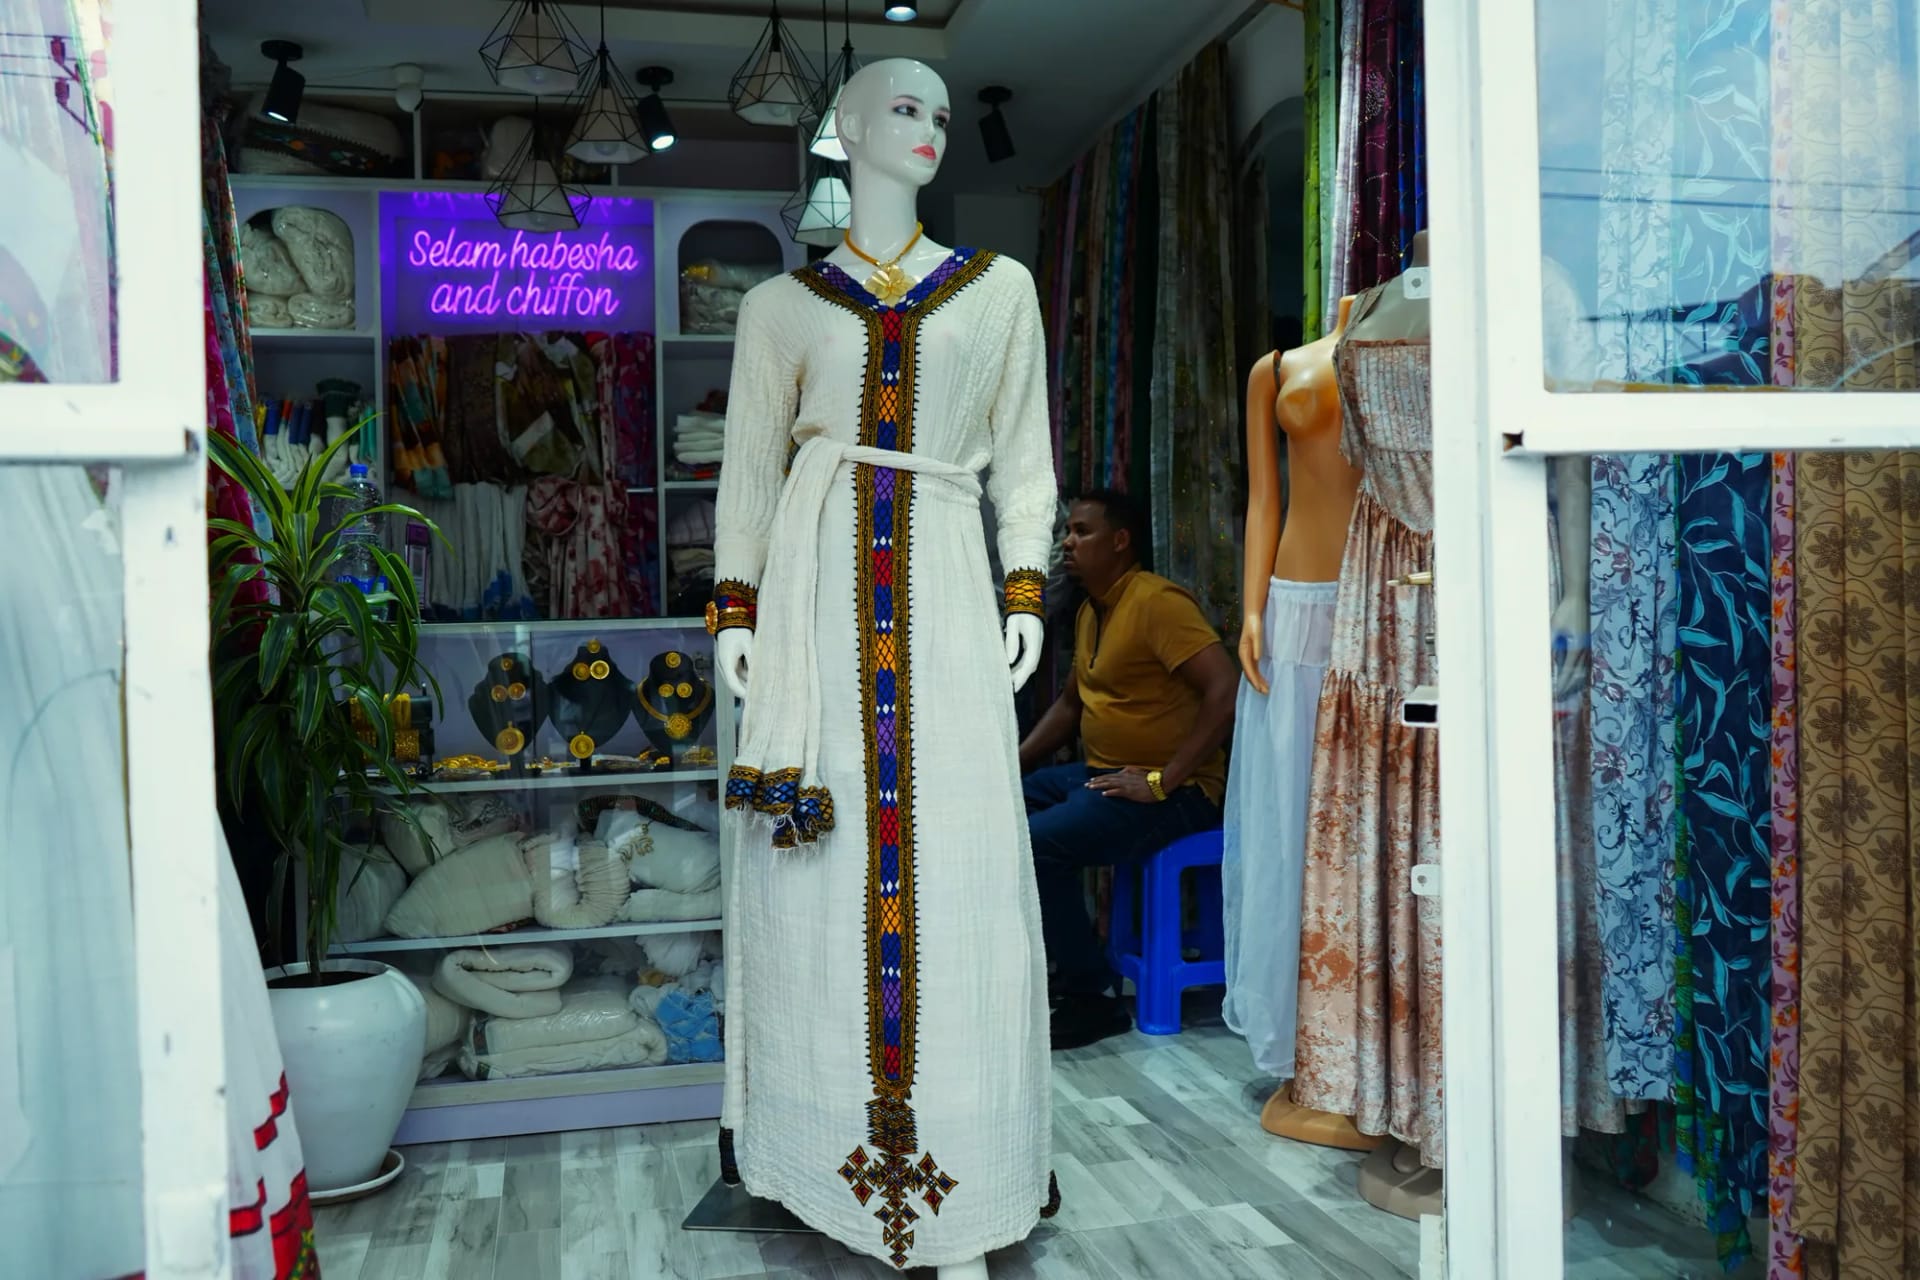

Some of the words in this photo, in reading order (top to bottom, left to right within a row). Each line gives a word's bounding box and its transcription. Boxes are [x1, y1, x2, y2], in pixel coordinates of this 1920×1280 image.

[408, 228, 507, 268] Selam
[508, 230, 638, 271] habesha
[430, 270, 500, 315] and
[505, 271, 620, 315] chiffon
